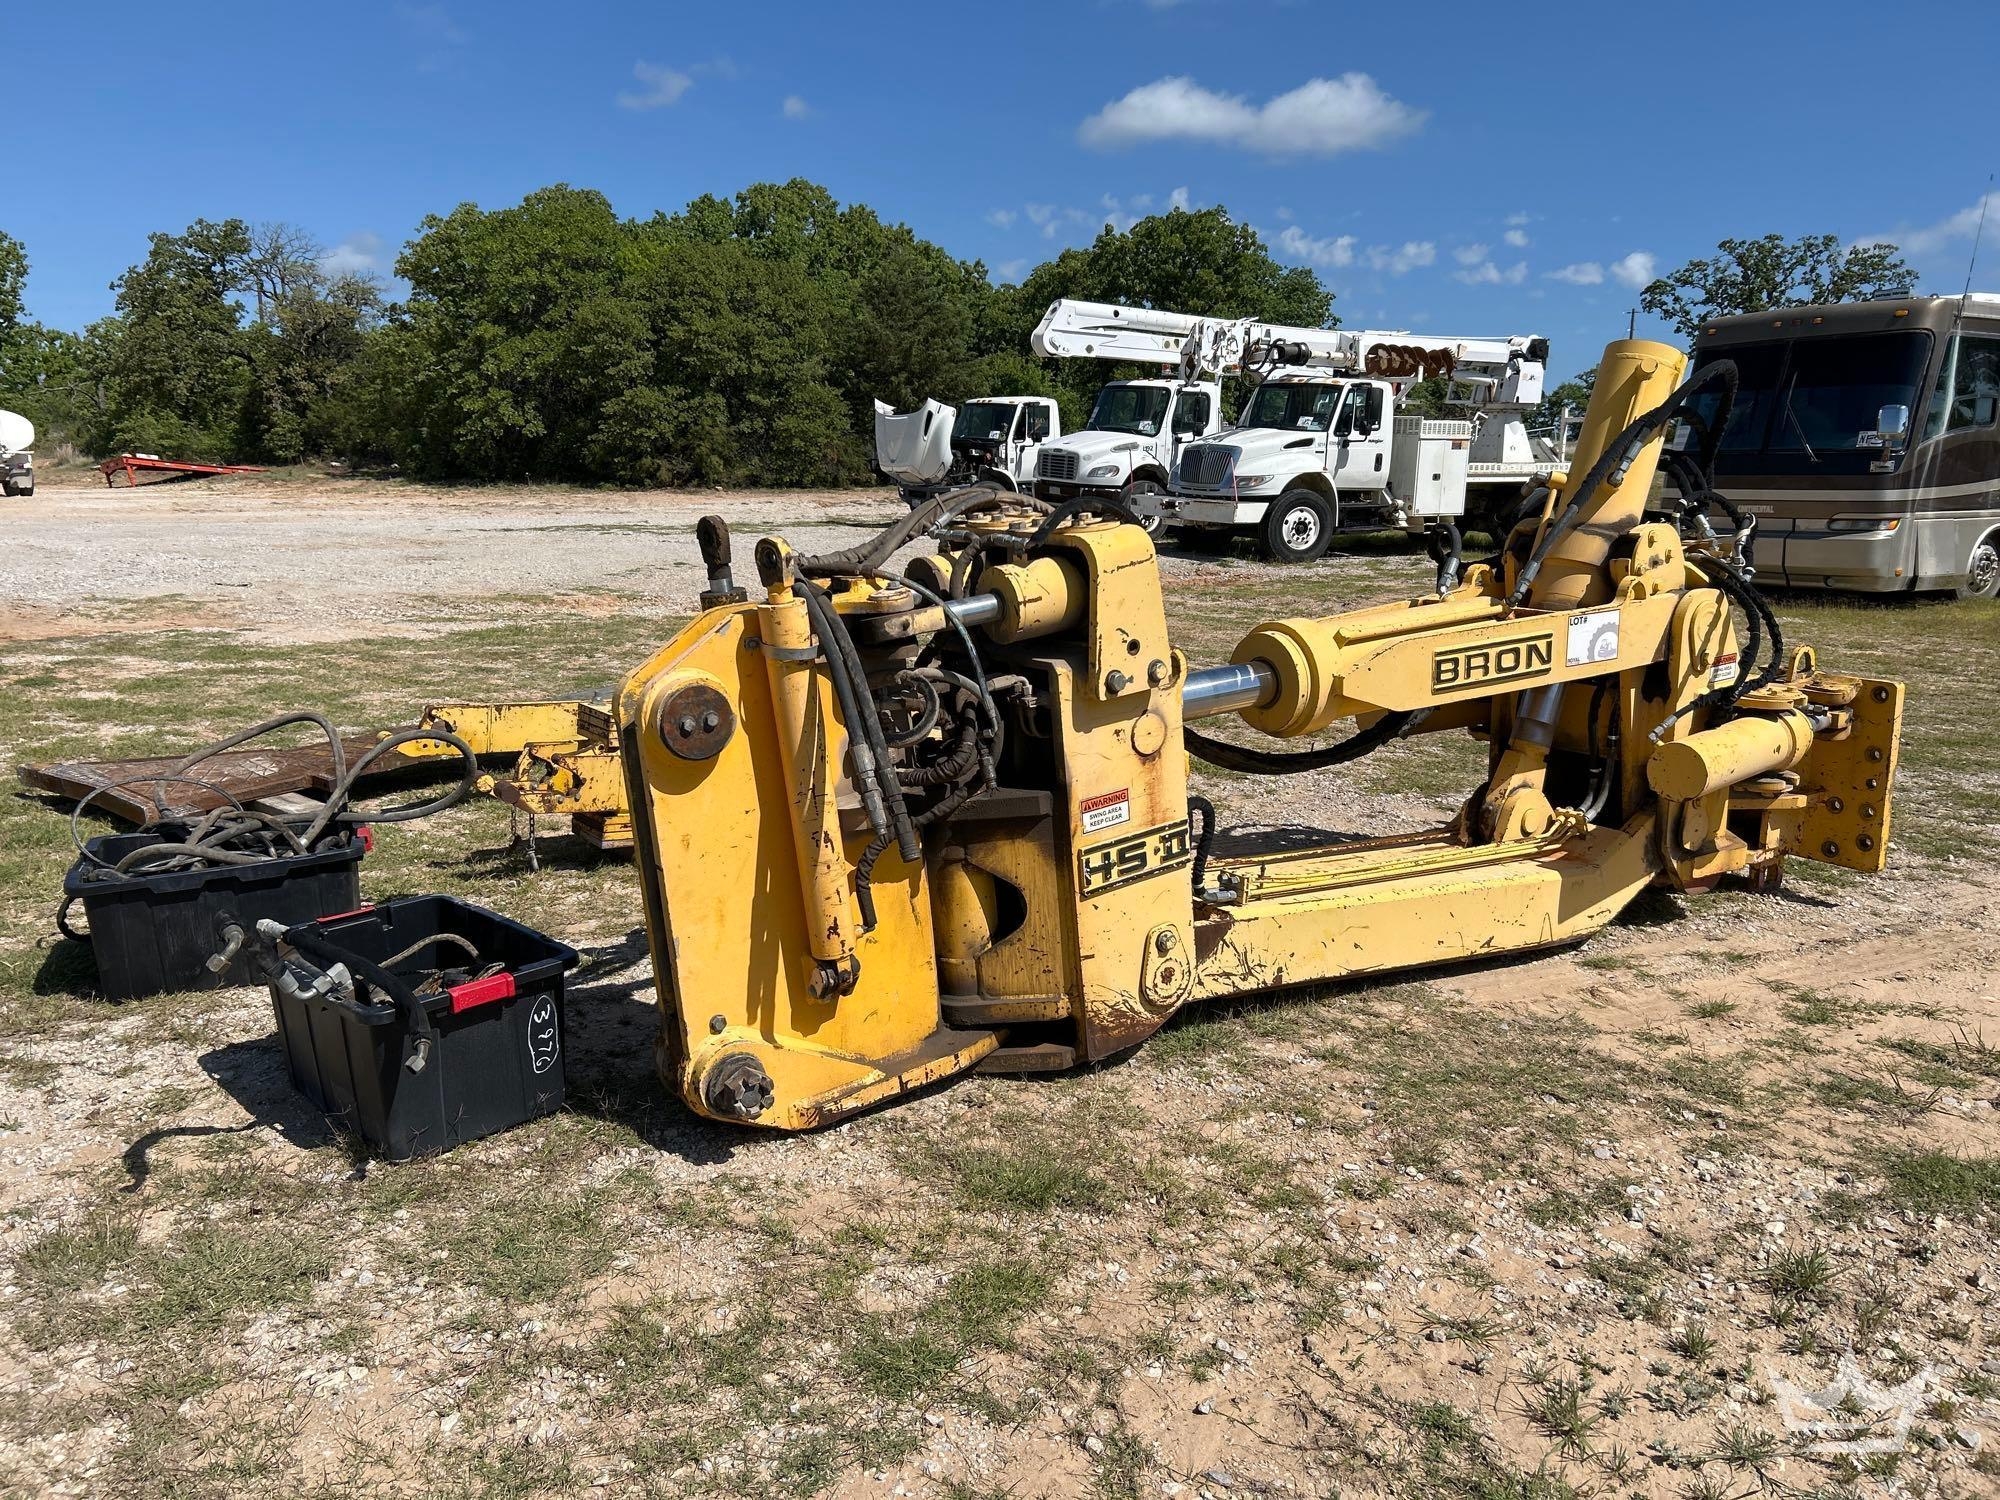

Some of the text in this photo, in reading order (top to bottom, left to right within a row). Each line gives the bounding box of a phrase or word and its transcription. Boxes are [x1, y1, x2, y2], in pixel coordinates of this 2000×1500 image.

[1569, 616, 1588, 626] LOT#
[1435, 640, 1552, 684] BRON
[1090, 792, 1126, 809] WARNING
[1089, 806, 1122, 821] SWING AREA
[1090, 813, 1123, 827] KEEP CLEAR
